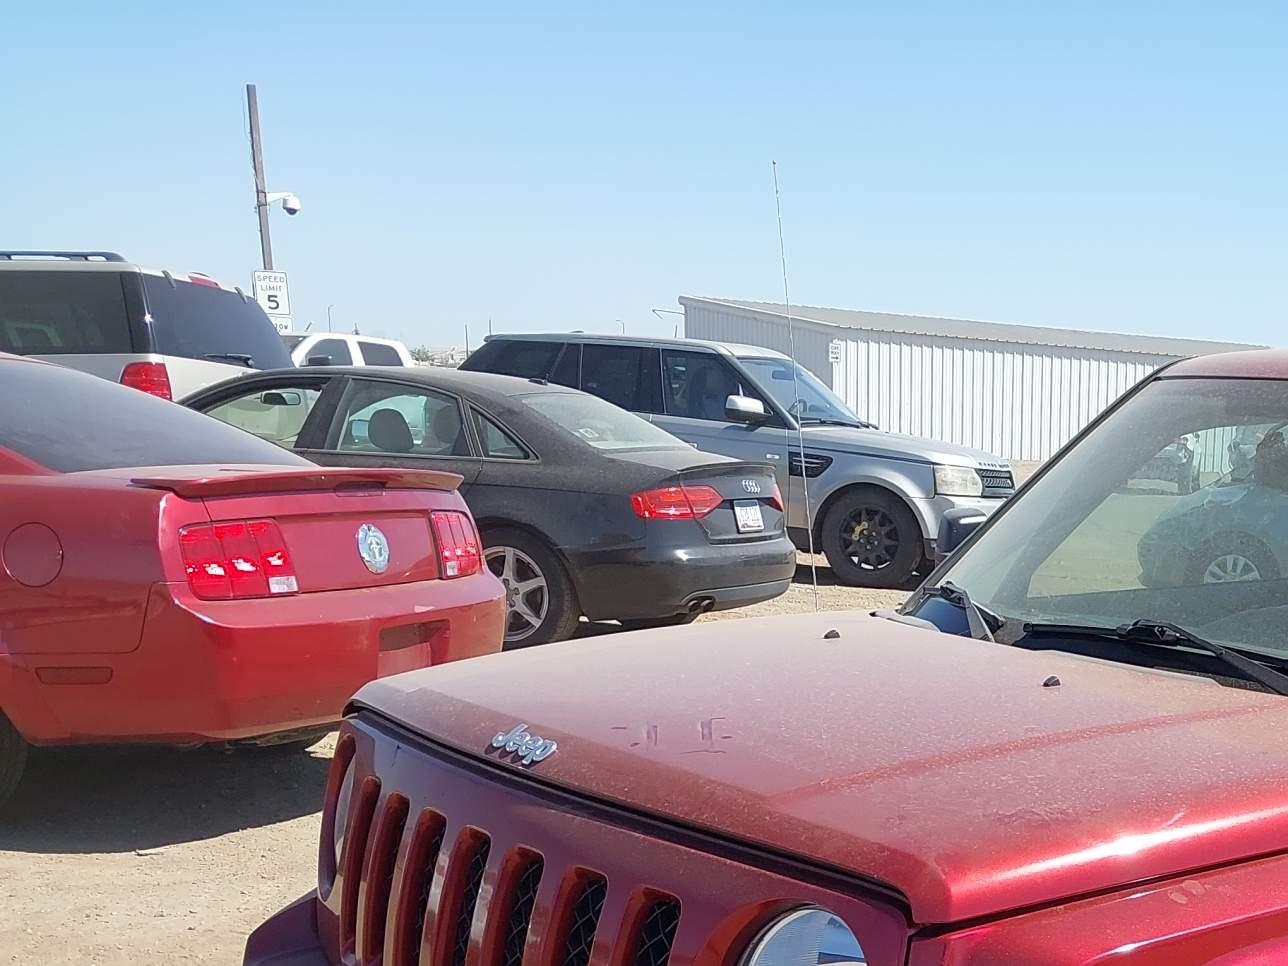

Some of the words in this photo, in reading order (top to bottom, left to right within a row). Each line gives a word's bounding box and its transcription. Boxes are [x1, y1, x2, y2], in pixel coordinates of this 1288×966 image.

[257, 275, 285, 283] SPEED
[260, 284, 283, 292] LIMIT
[267, 294, 280, 310] 5
[491, 723, 557, 765] Jeep
